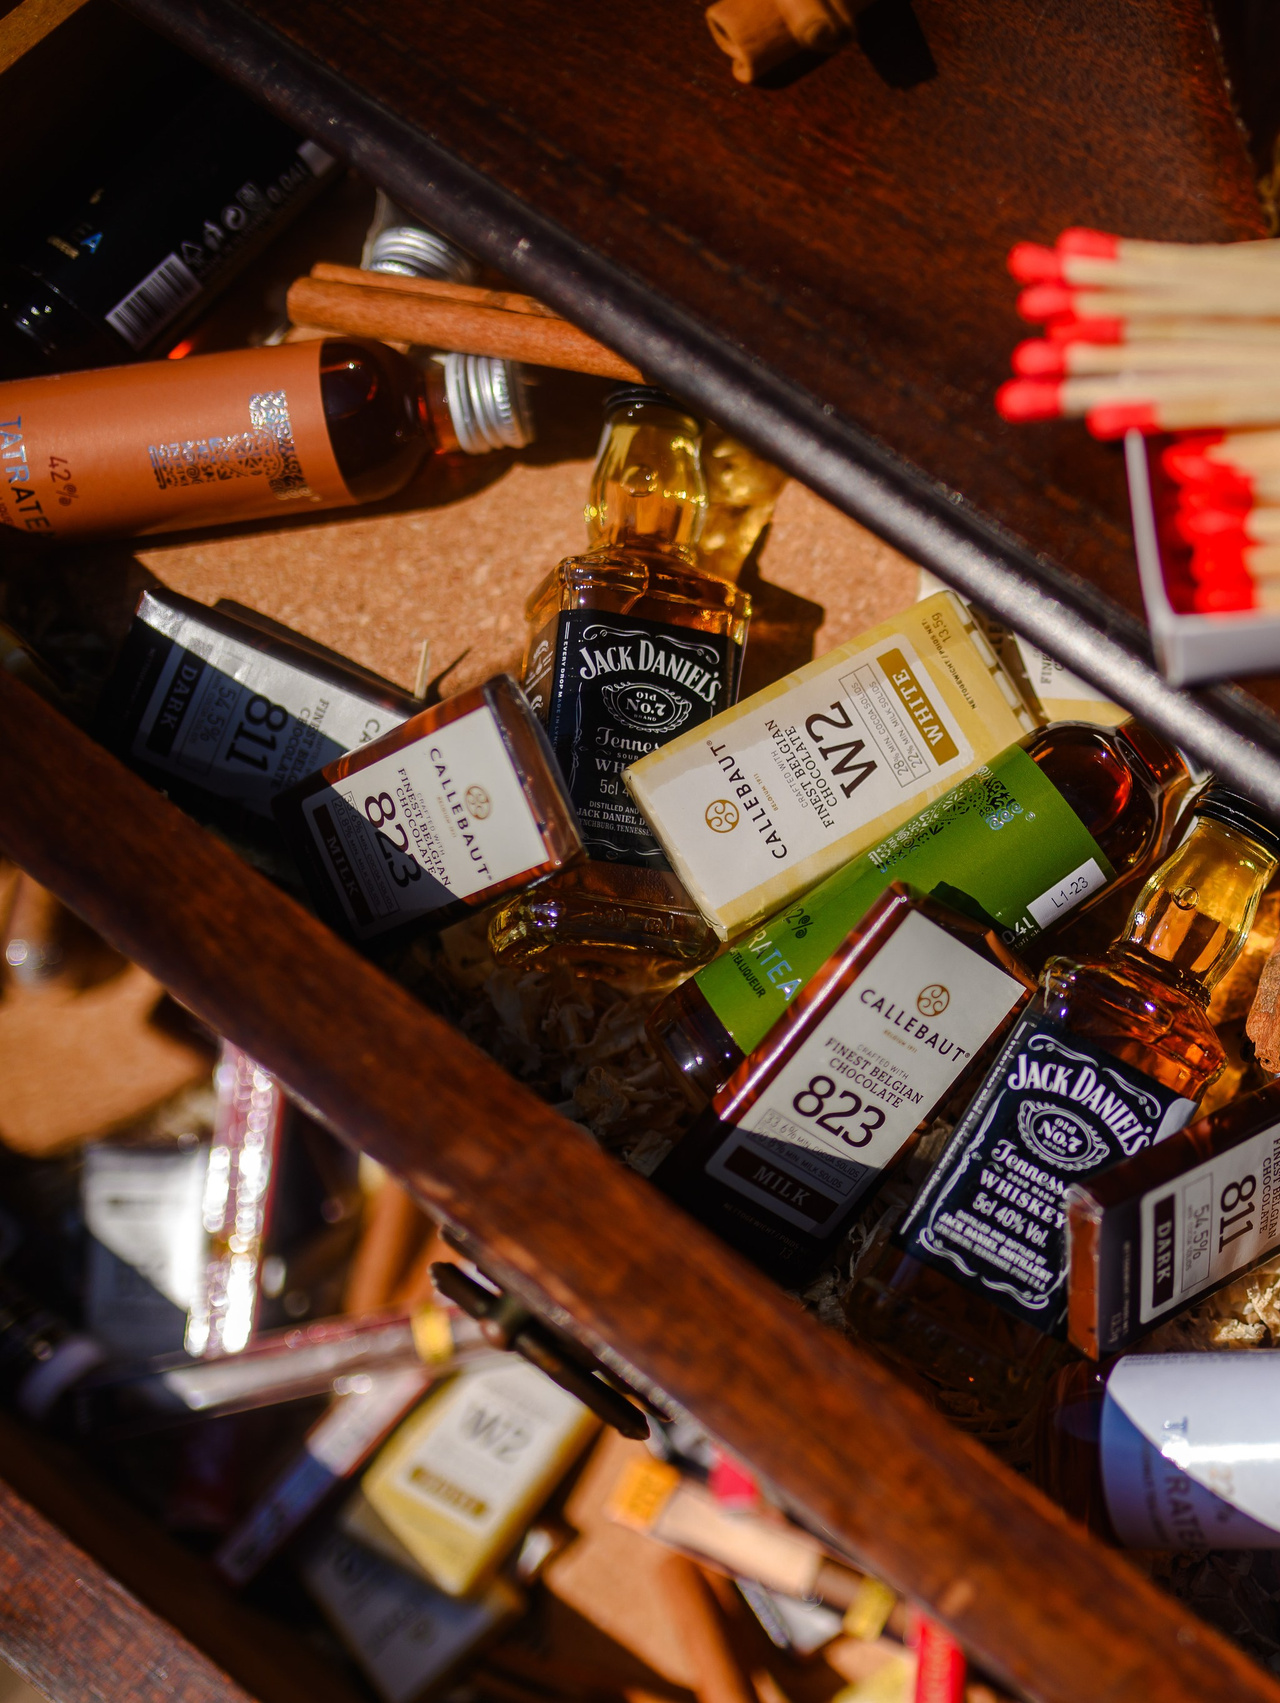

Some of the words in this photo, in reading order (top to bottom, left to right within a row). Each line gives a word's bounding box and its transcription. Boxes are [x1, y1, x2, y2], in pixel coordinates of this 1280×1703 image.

[0, 415, 55, 537] TATRATE
[932, 612, 952, 643] 13,5g
[160, 663, 198, 731] DARK
[579, 646, 635, 680] JACK
[638, 639, 722, 704] DANIEL'S
[636, 691, 657, 701] Old
[851, 682, 869, 709] SOLIDS
[869, 681, 888, 709] SOLIDS
[226, 694, 289, 772] 811
[868, 708, 886, 736] COCOA
[885, 708, 900, 728] MILK
[892, 669, 944, 746] WHITE
[764, 719, 806, 779] BELGIAN
[770, 750, 786, 771] WITH
[784, 725, 838, 808] CHOCOLATE
[805, 701, 878, 798] W2
[892, 754, 908, 776] 28%
[907, 746, 923, 769] 22%
[589, 800, 624, 813] DISTILLED
[624, 806, 640, 815] AND
[600, 779, 619, 796] 5cl
[783, 773, 808, 808] CRAFTED
[800, 781, 835, 829] FINEST
[364, 791, 422, 888] 823
[396, 787, 437, 876] CHOCOLATE
[397, 768, 424, 819] FINEST
[420, 822, 452, 887] BELGIAN
[576, 808, 601, 820] JACK
[602, 811, 637, 825] DANIEL
[326, 834, 361, 897] MILK
[1051, 877, 1088, 908] L1-23
[739, 962, 766, 998] LIQUEUR
[748, 929, 803, 1001] RATEA
[824, 1037, 871, 1071] FINEST
[869, 1066, 924, 1105] BELGIAN
[829, 1057, 904, 1109] CHOCOLATE
[857, 1044, 890, 1068] CRAFTED
[890, 1065, 909, 1080] WITH
[792, 1075, 886, 1148] 823
[1007, 1053, 1074, 1096] JACK
[1068, 1066, 1153, 1156] DANIEL'S
[1054, 1117, 1077, 1136] Old
[752, 1164, 812, 1207] MILK
[801, 1160, 817, 1174] MILK
[818, 1170, 844, 1189] SOLIDS
[834, 1160, 860, 1178] SOLIDS
[972, 1191, 998, 1217] 5cl
[994, 1206, 1027, 1234] 40%
[1025, 1220, 1049, 1249] Vol.
[979, 1169, 1069, 1230] WHISKEY
[1218, 1174, 1257, 1253] 811
[1259, 1157, 1272, 1234] CHOCOLATE
[1268, 1186, 1280, 1239] BELGIAN
[938, 1211, 966, 1234] JACK
[963, 1225, 999, 1253] DANIEL
[1156, 1219, 1172, 1285] DARK
